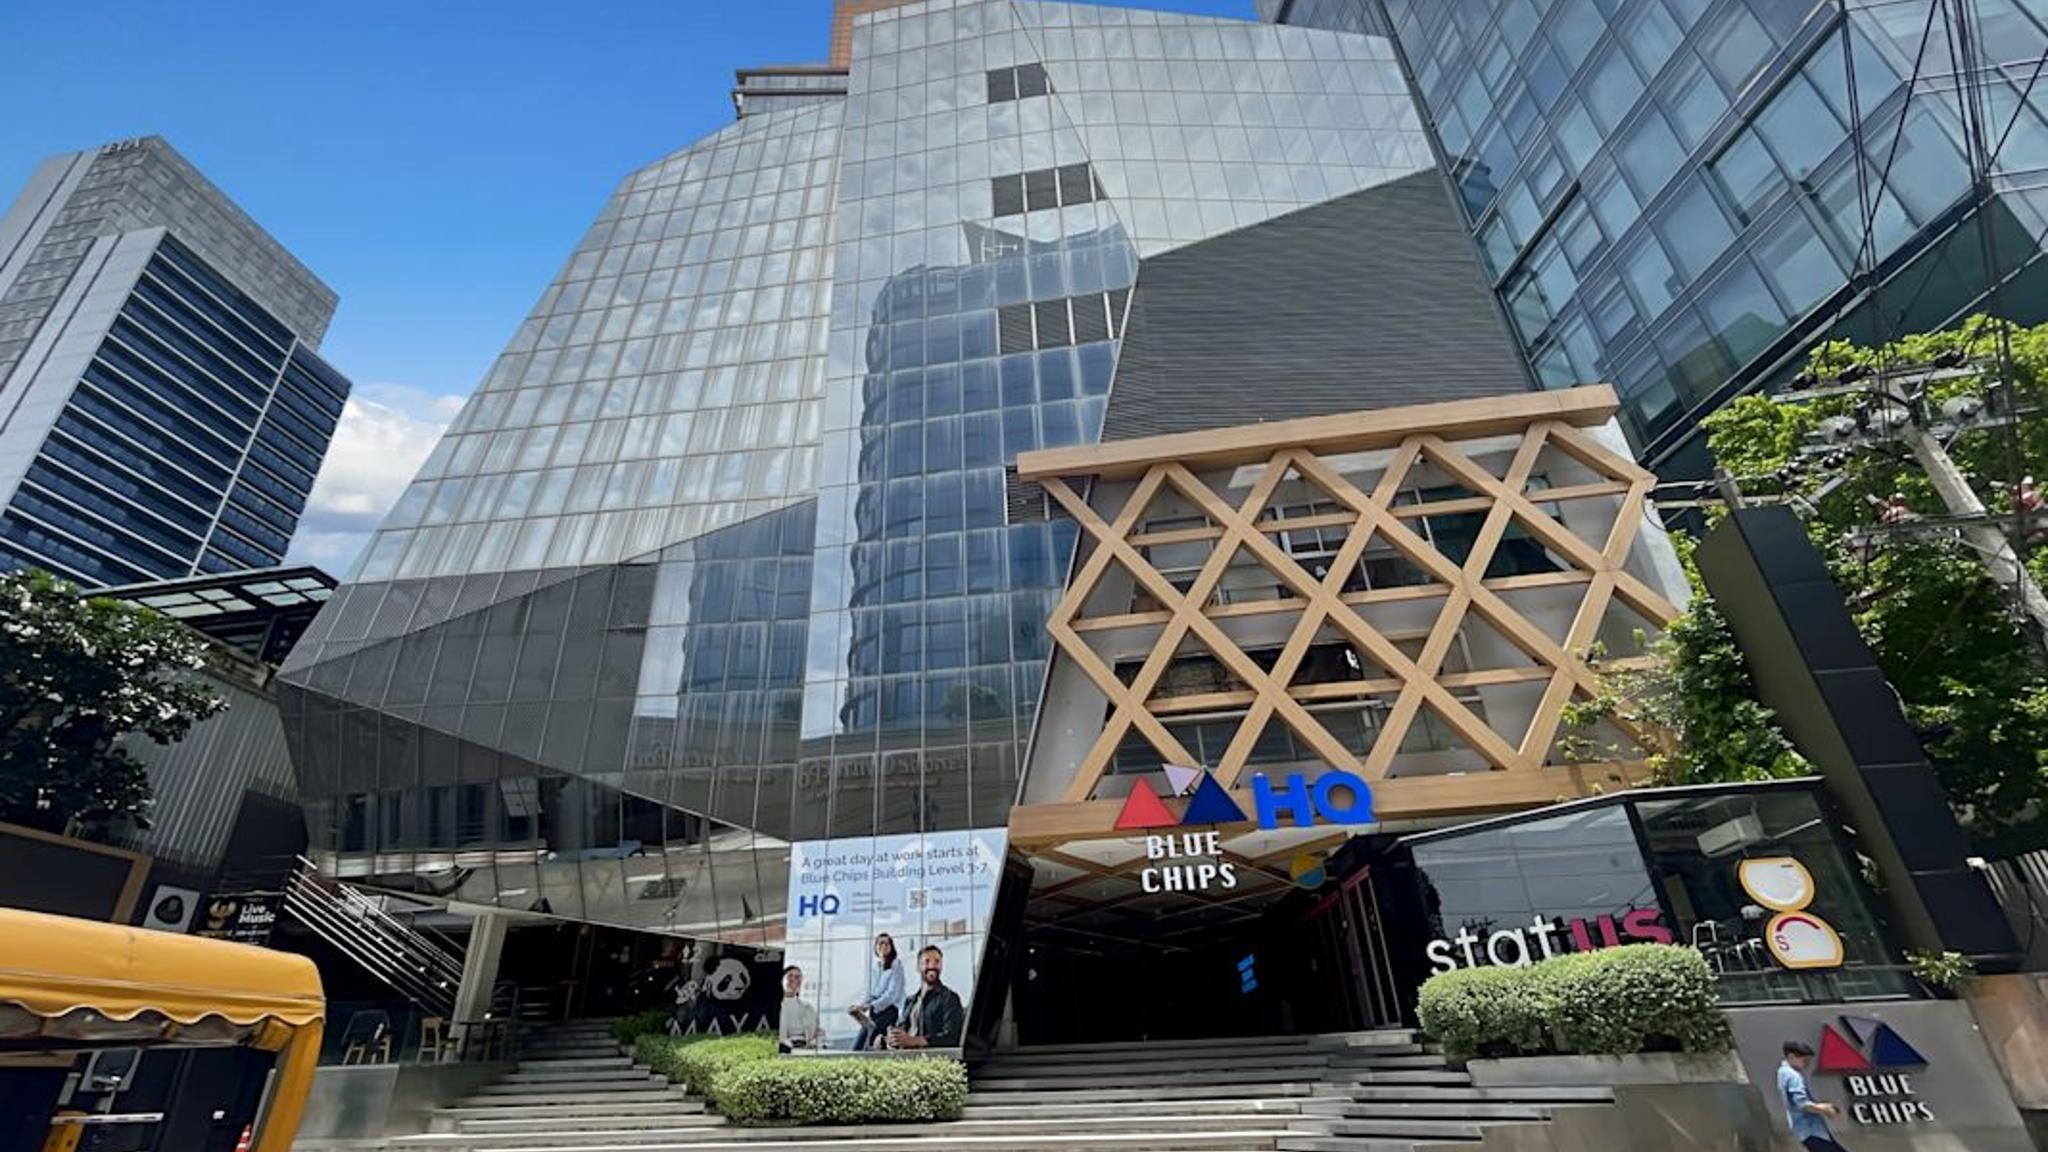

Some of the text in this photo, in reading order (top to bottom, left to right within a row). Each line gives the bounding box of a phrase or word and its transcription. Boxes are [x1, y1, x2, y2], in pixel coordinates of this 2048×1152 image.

[1252, 770, 1376, 830] HQ
[813, 853, 847, 870] great
[849, 851, 875, 868] day
[876, 850, 889, 863] at
[891, 848, 924, 862] work
[926, 845, 963, 859] starts
[965, 844, 979, 857] at
[1145, 831, 1224, 860] BLUE
[801, 870, 828, 884] Blue
[832, 867, 869, 884] Chips
[872, 864, 925, 881] Building
[928, 861, 964, 877] Level
[1141, 863, 1237, 893] CHIPS
[238, 911, 276, 924] Music
[241, 904, 267, 914] Live
[797, 893, 841, 918] HQ
[1426, 907, 1673, 976] status
[669, 1012, 771, 1035] MAYA
[1849, 1074, 1916, 1097] BLUE
[1853, 1101, 1935, 1124] CHIPS
